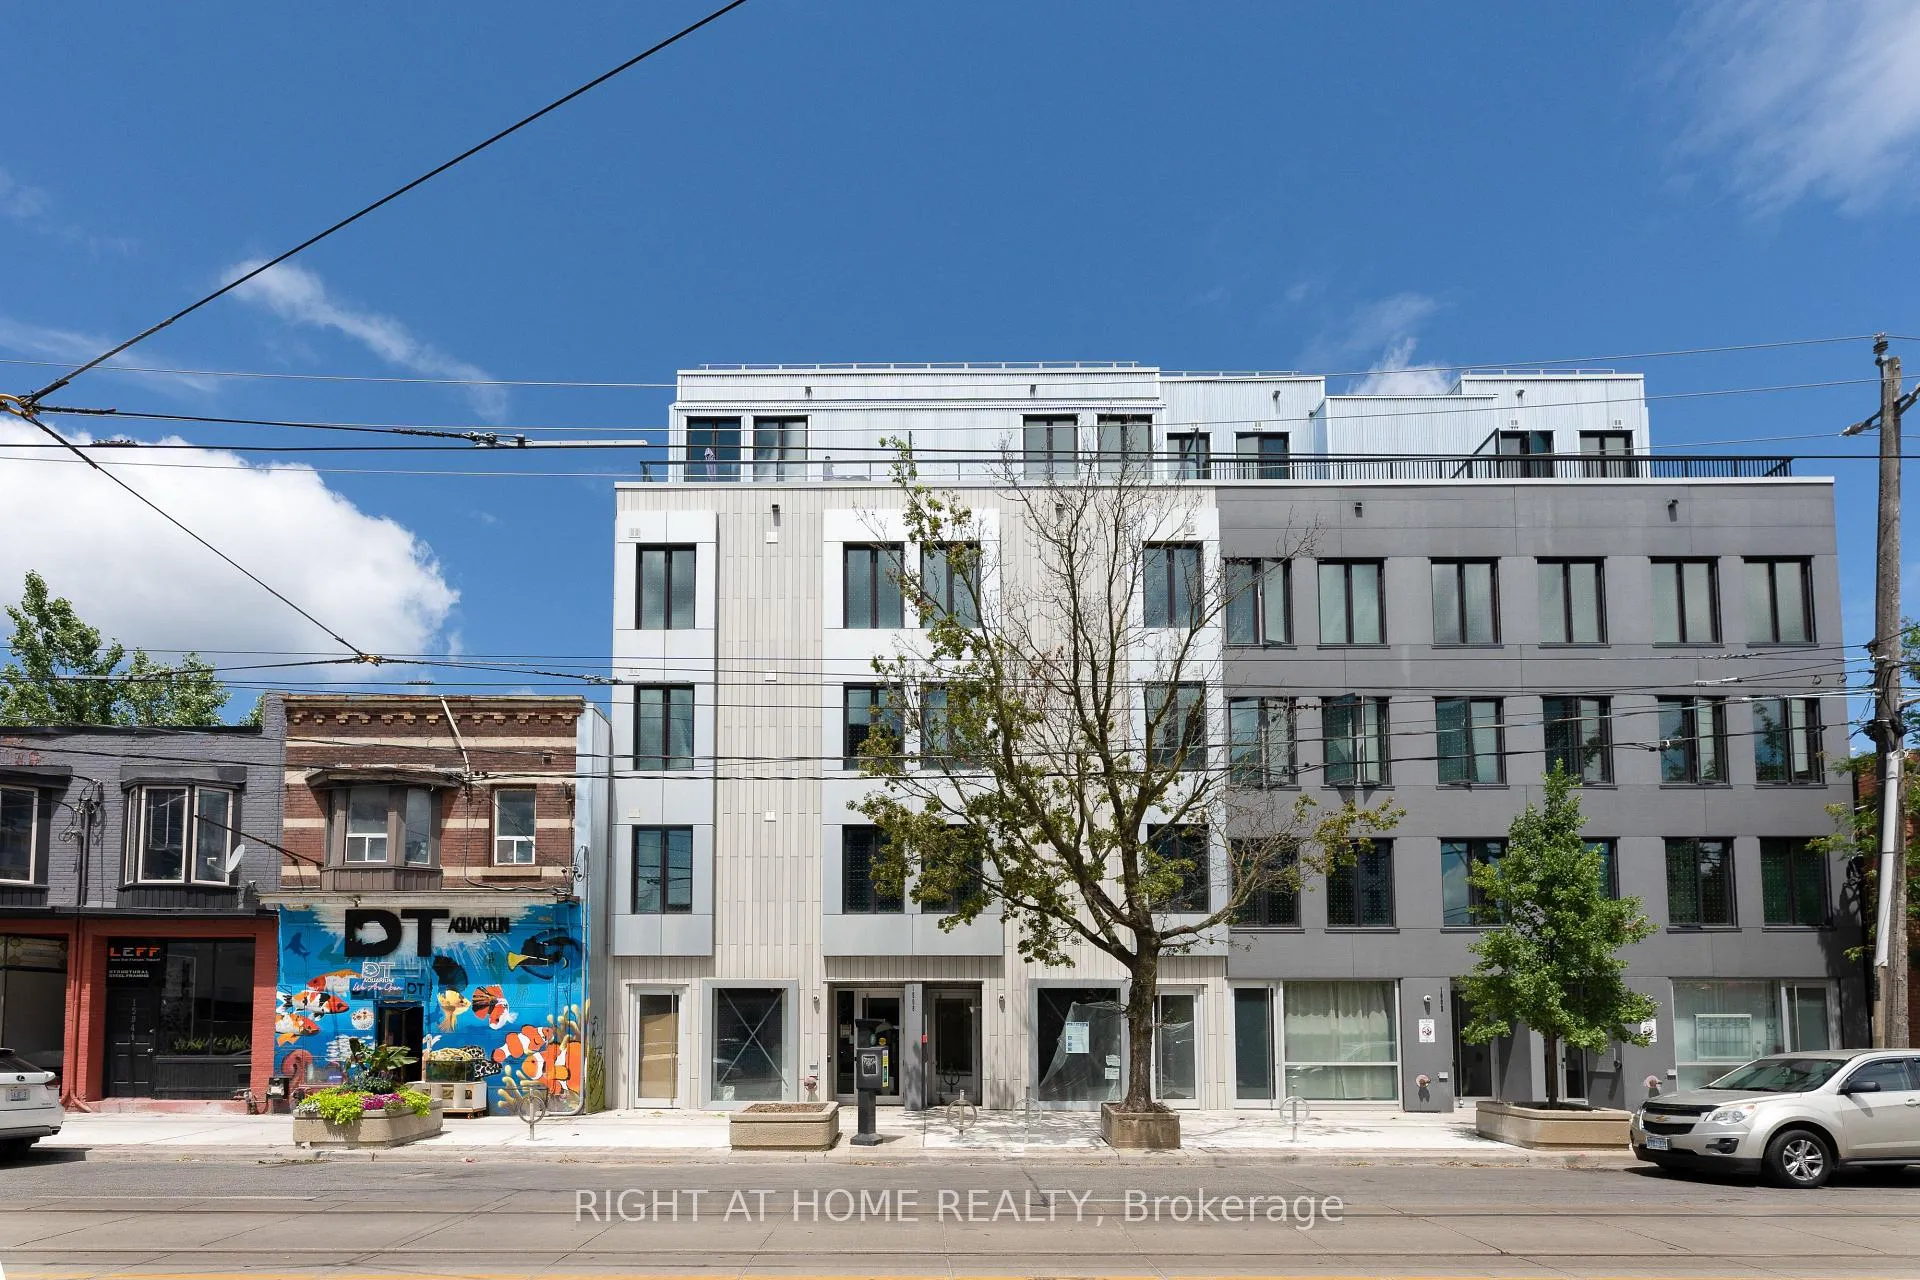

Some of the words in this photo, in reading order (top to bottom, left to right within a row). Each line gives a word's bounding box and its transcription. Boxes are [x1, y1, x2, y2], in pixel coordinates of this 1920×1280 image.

[345, 908, 450, 958] DT
[447, 916, 510, 934] AQUARIUM
[110, 947, 161, 957] LEFF
[361, 961, 396, 979] DT
[407, 982, 426, 995] DT
